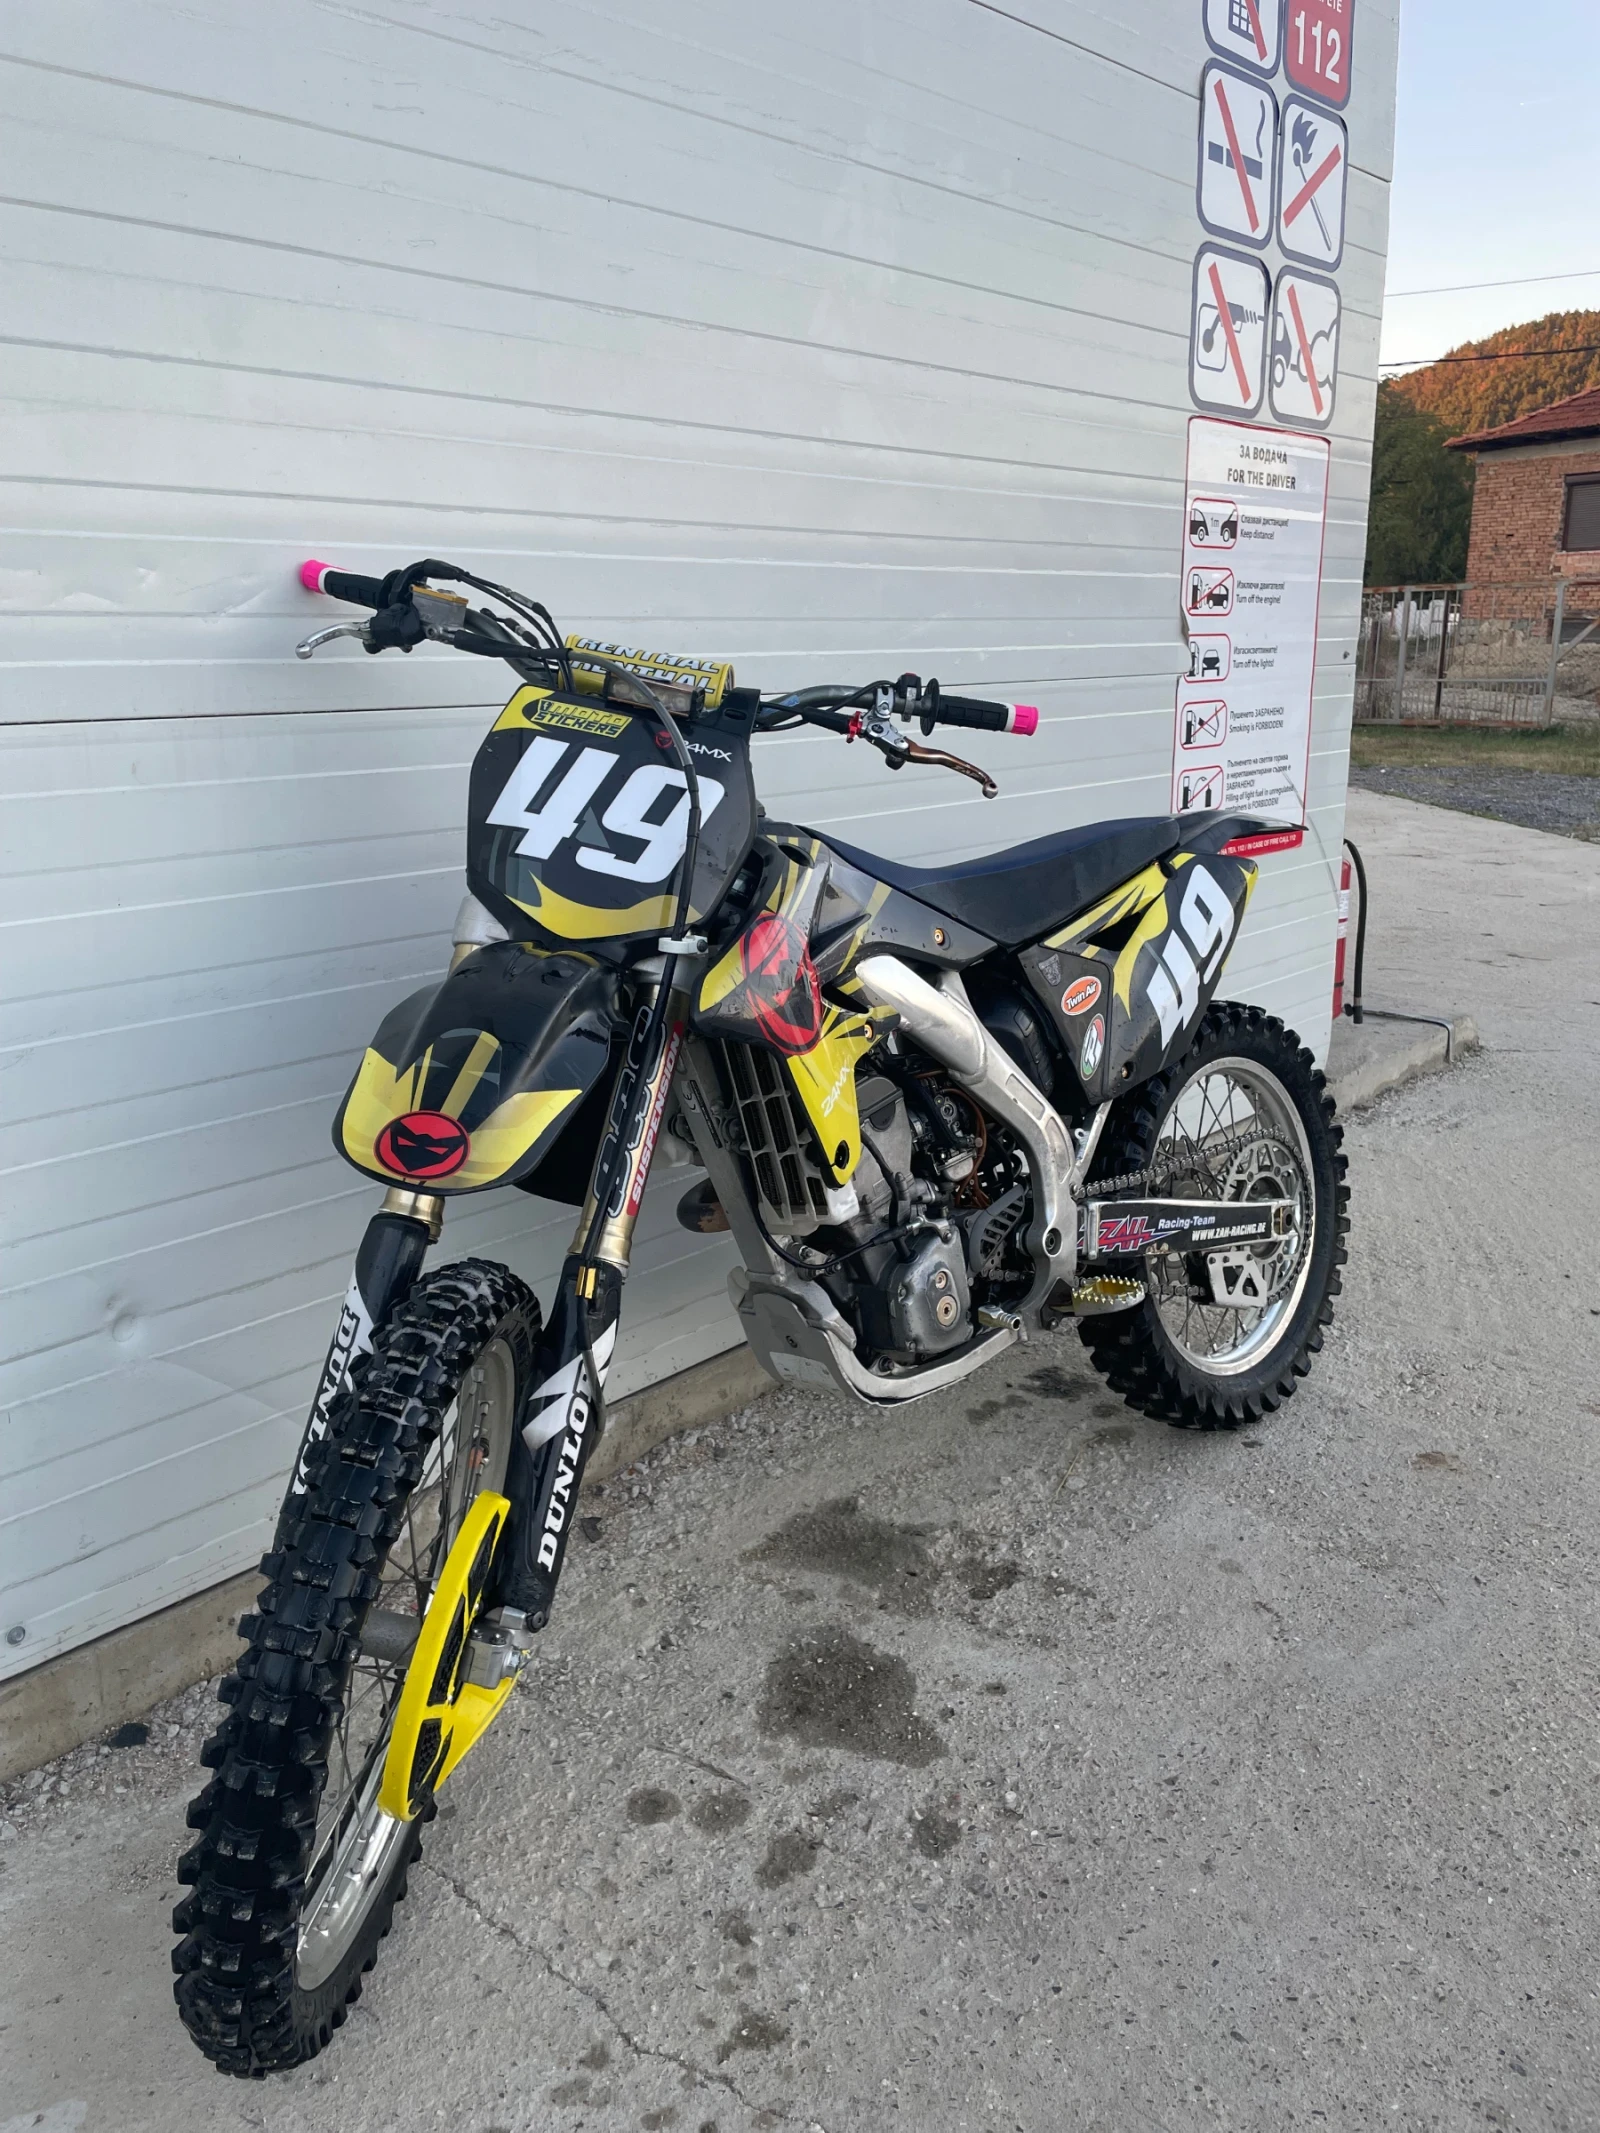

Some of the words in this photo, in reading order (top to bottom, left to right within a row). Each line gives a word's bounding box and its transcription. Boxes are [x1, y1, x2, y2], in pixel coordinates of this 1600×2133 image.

[1294, 10, 1341, 84] 112
[1240, 444, 1250, 459] ЗА
[1253, 446, 1288, 465] ВОДАЧА
[1227, 467, 1245, 483] FOR
[1247, 470, 1264, 485] THE
[1266, 472, 1296, 490] DRIVER
[1240, 529, 1252, 540] Keep
[1253, 530, 1275, 540] distance!
[1236, 594, 1247, 603] Turn
[1255, 595, 1263, 603] the
[575, 637, 721, 674] RENTHAL
[1233, 660, 1243, 668] Turn
[1251, 659, 1260, 668] the
[534, 711, 622, 736] STICKERS
[1229, 724, 1250, 734] Smoking
[485, 736, 725, 883] 49
[1253, 841, 1264, 849] CASE
[1270, 838, 1279, 846] FIRE
[1289, 834, 1297, 842] 112
[1066, 992, 1086, 1010] Twin
[1085, 981, 1097, 998] Air
[630, 1031, 681, 1206] SUSPENSION
[1158, 1216, 1216, 1230] Racing-Team
[1191, 1222, 1267, 1242] WWW.ZAH-RACING.DE
